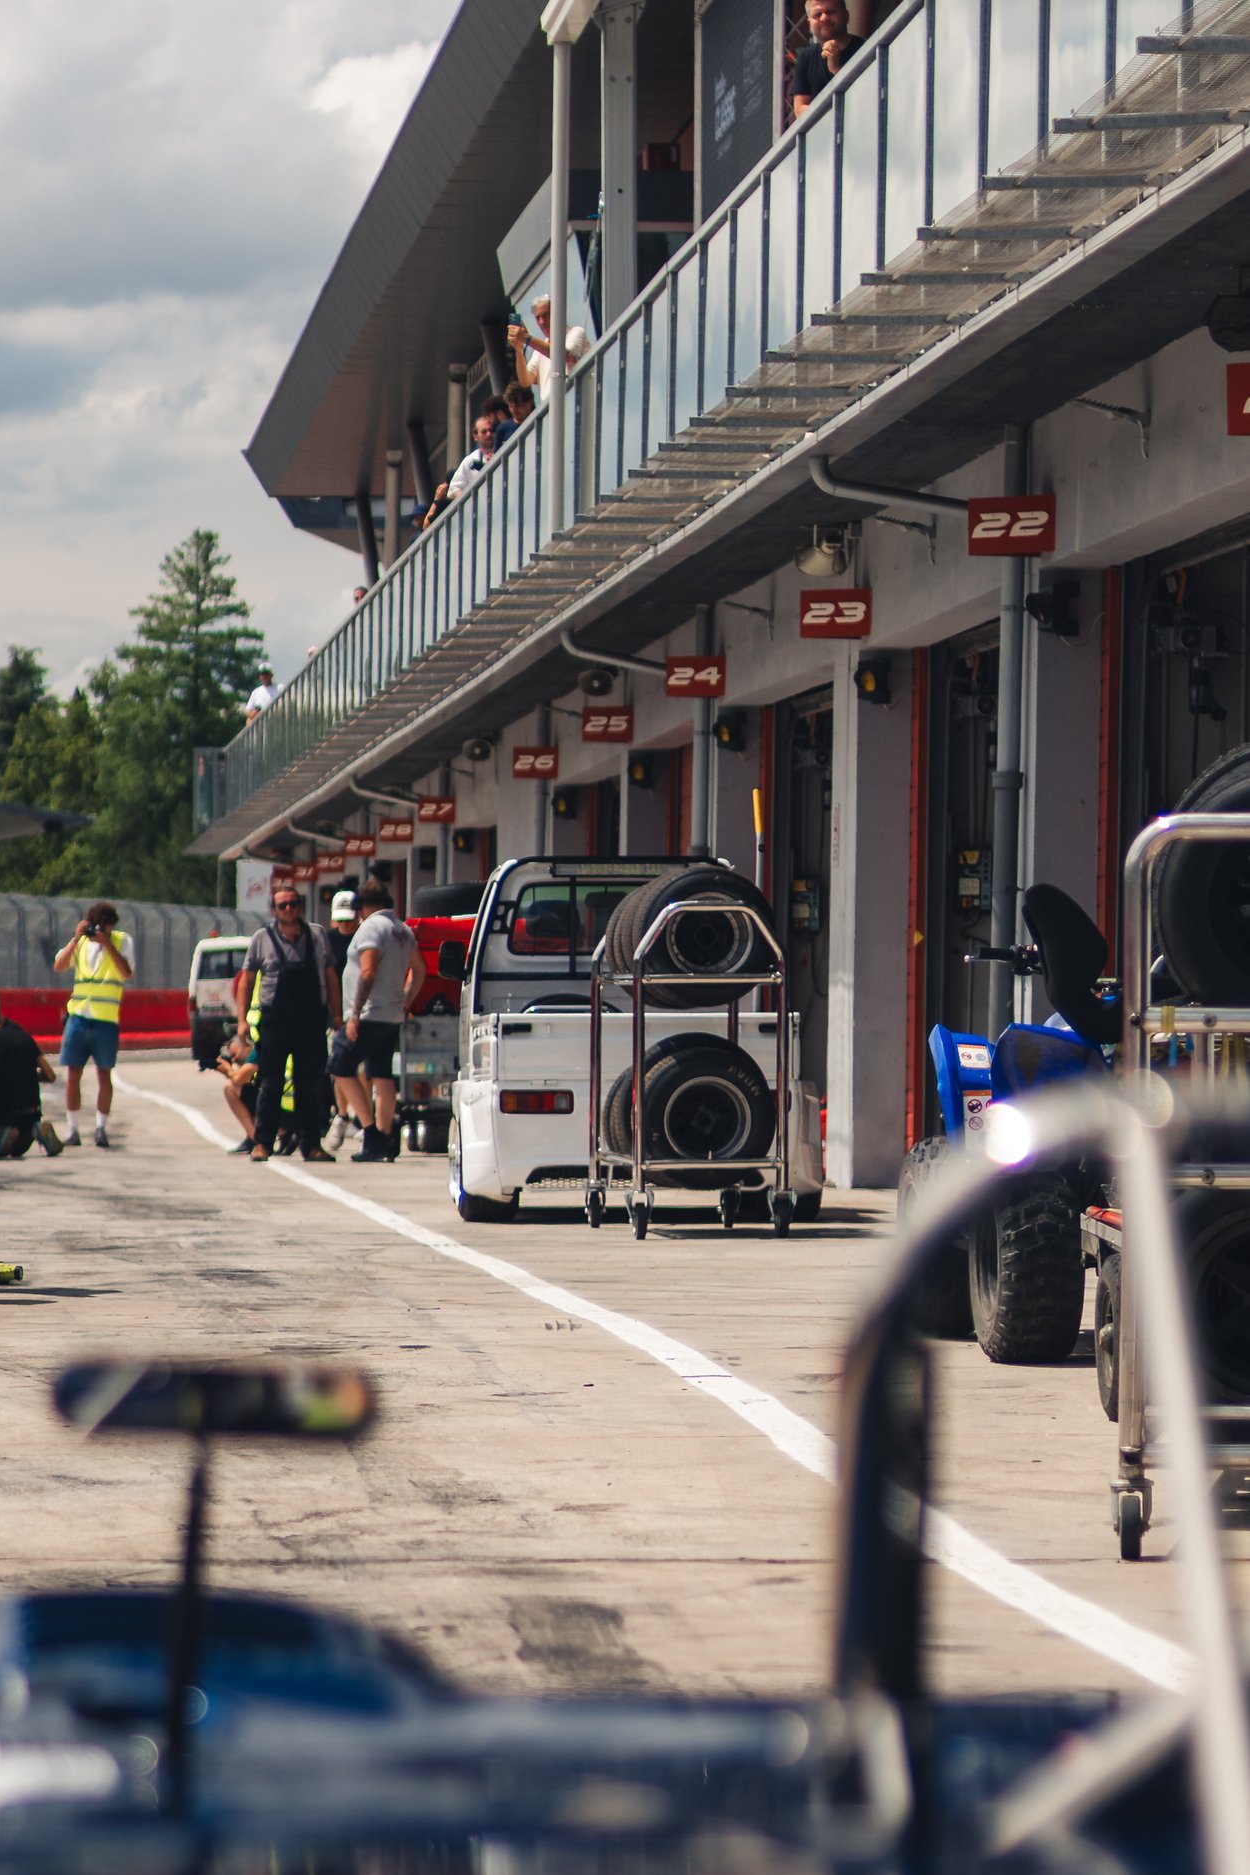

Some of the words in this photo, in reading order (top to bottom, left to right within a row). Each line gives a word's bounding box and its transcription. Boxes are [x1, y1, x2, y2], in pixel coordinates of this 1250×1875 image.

[971, 511, 1049, 538] 22
[802, 602, 866, 624] 23
[667, 667, 722, 685] 24
[584, 715, 629, 732] 25
[514, 754, 555, 769] 26
[420, 803, 453, 816] 27
[380, 823, 412, 837] 28
[346, 840, 374, 851] 29
